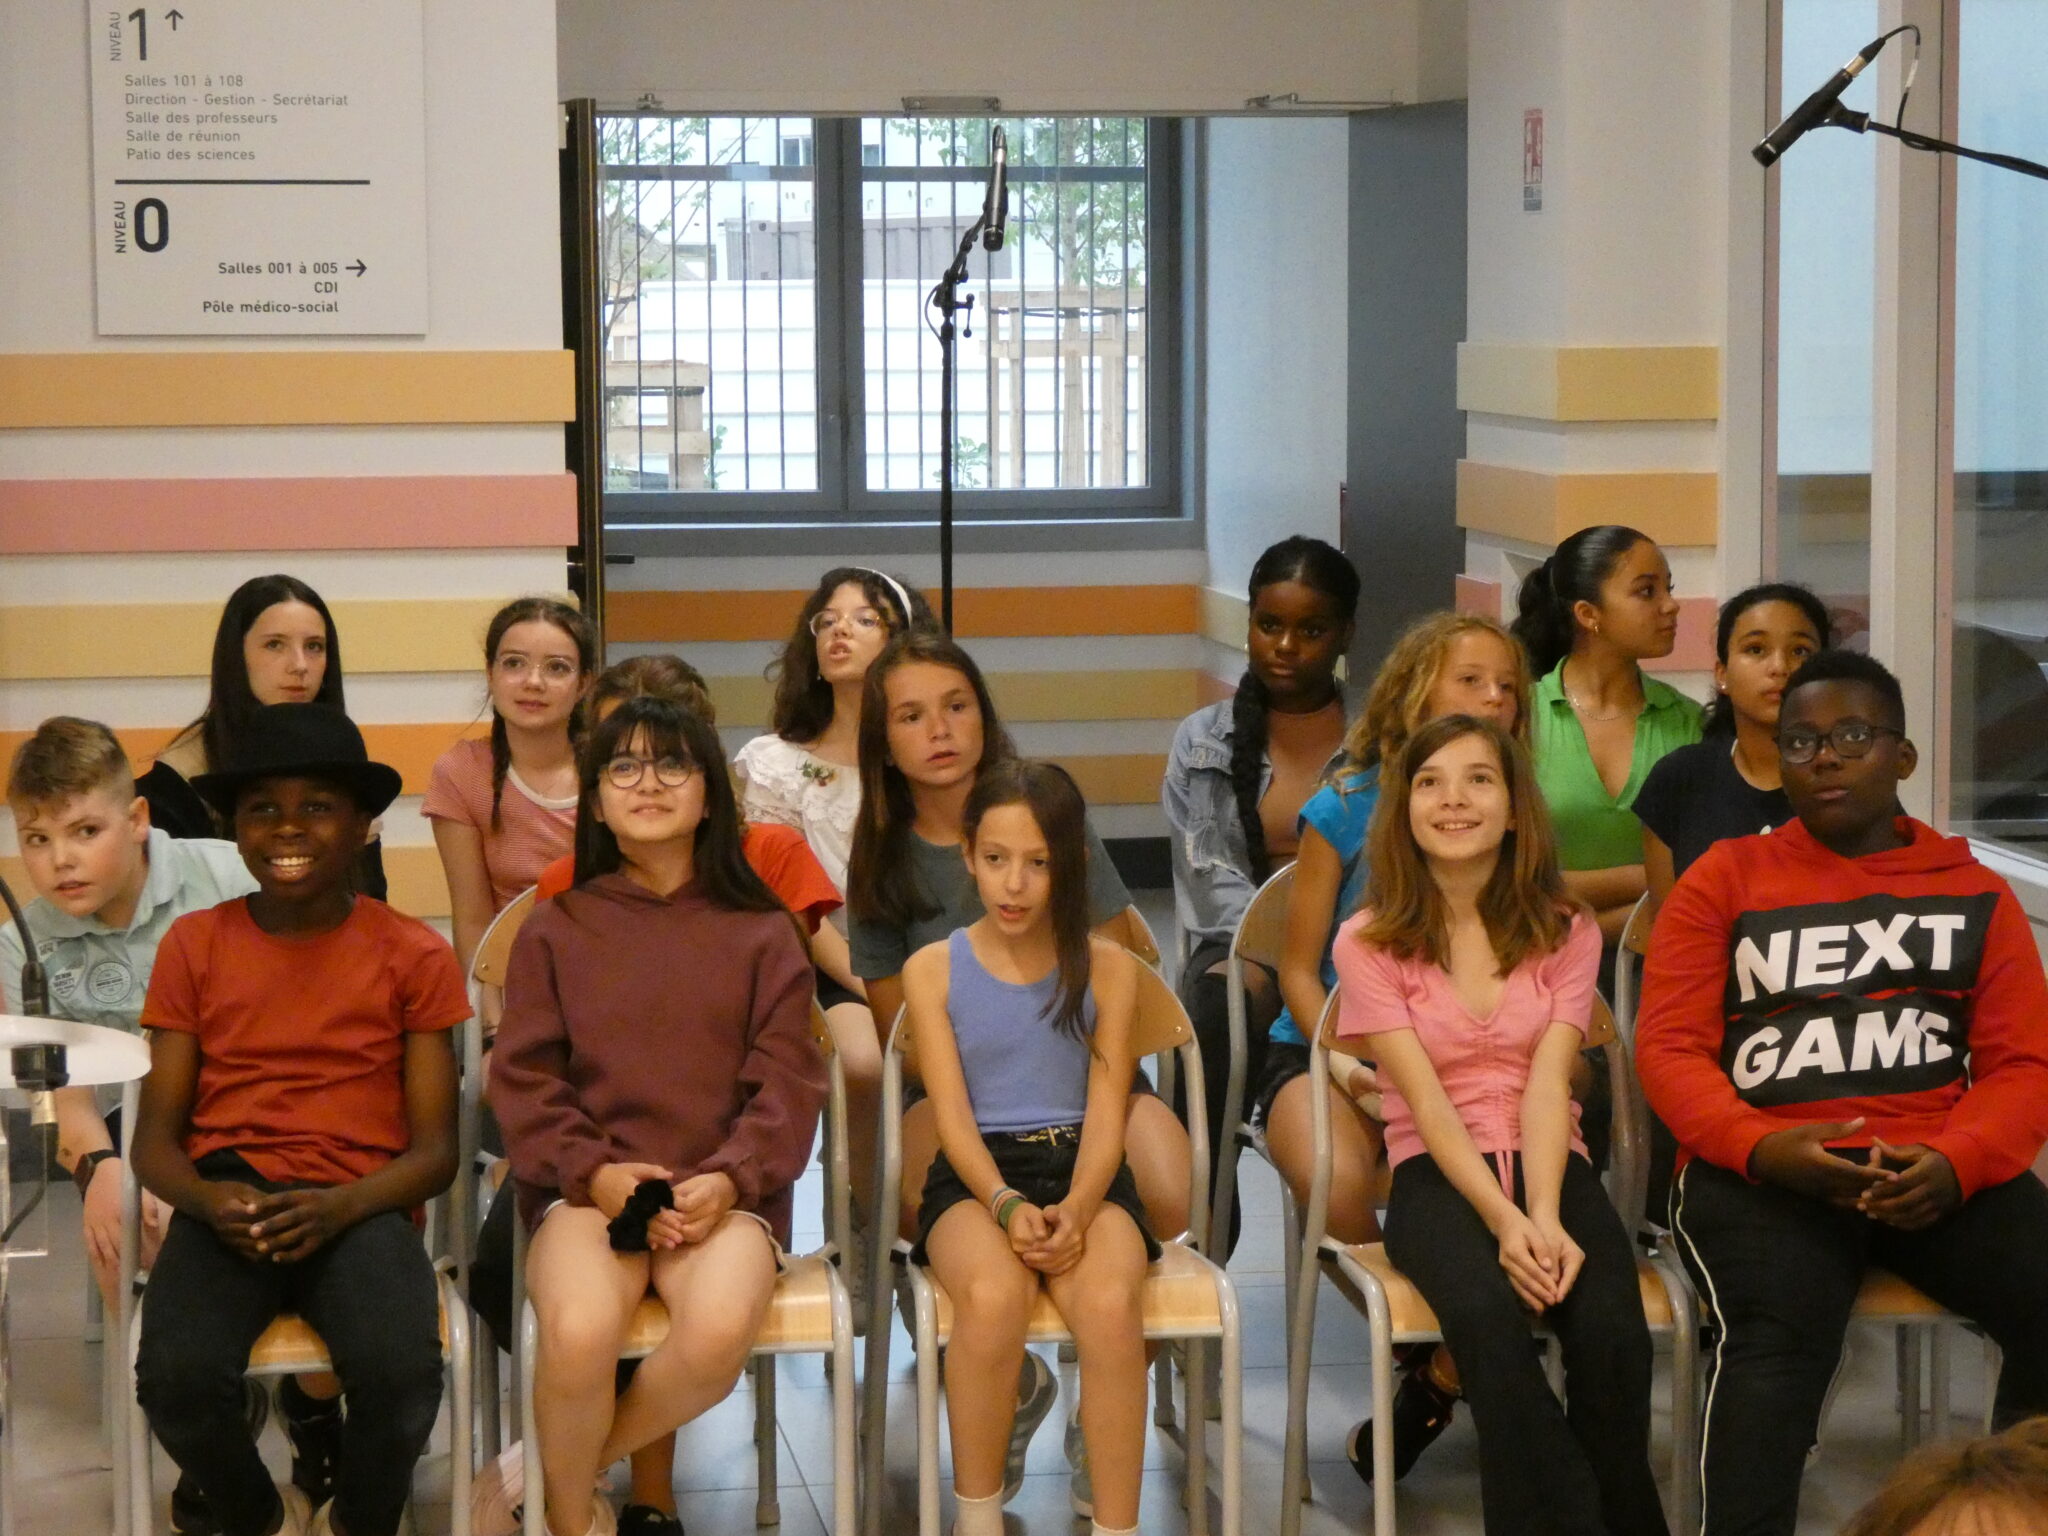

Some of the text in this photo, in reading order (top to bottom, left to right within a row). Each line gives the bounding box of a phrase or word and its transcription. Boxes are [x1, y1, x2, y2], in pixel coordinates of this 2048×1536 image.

[109, 12, 121, 61] NIVEAU
[129, 8, 147, 61] 1
[125, 74, 243, 87] Salles 101 à 108
[125, 93, 186, 105] Direction
[205, 93, 255, 105] Gestion
[273, 94, 348, 105] Secrétariat
[126, 111, 277, 125] Salle des professeurs
[126, 129, 240, 142] Salle de réunion
[127, 148, 255, 160] Patio des sciences
[114, 201, 126, 253] NIVEAU
[134, 198, 169, 253] 0
[219, 262, 337, 274] Salles 001 à 005
[314, 282, 337, 293] CDI
[203, 300, 338, 312] Pôle médico-social
[1735, 913, 1965, 1003] NEXT
[1733, 1008, 1952, 1089] GAME
